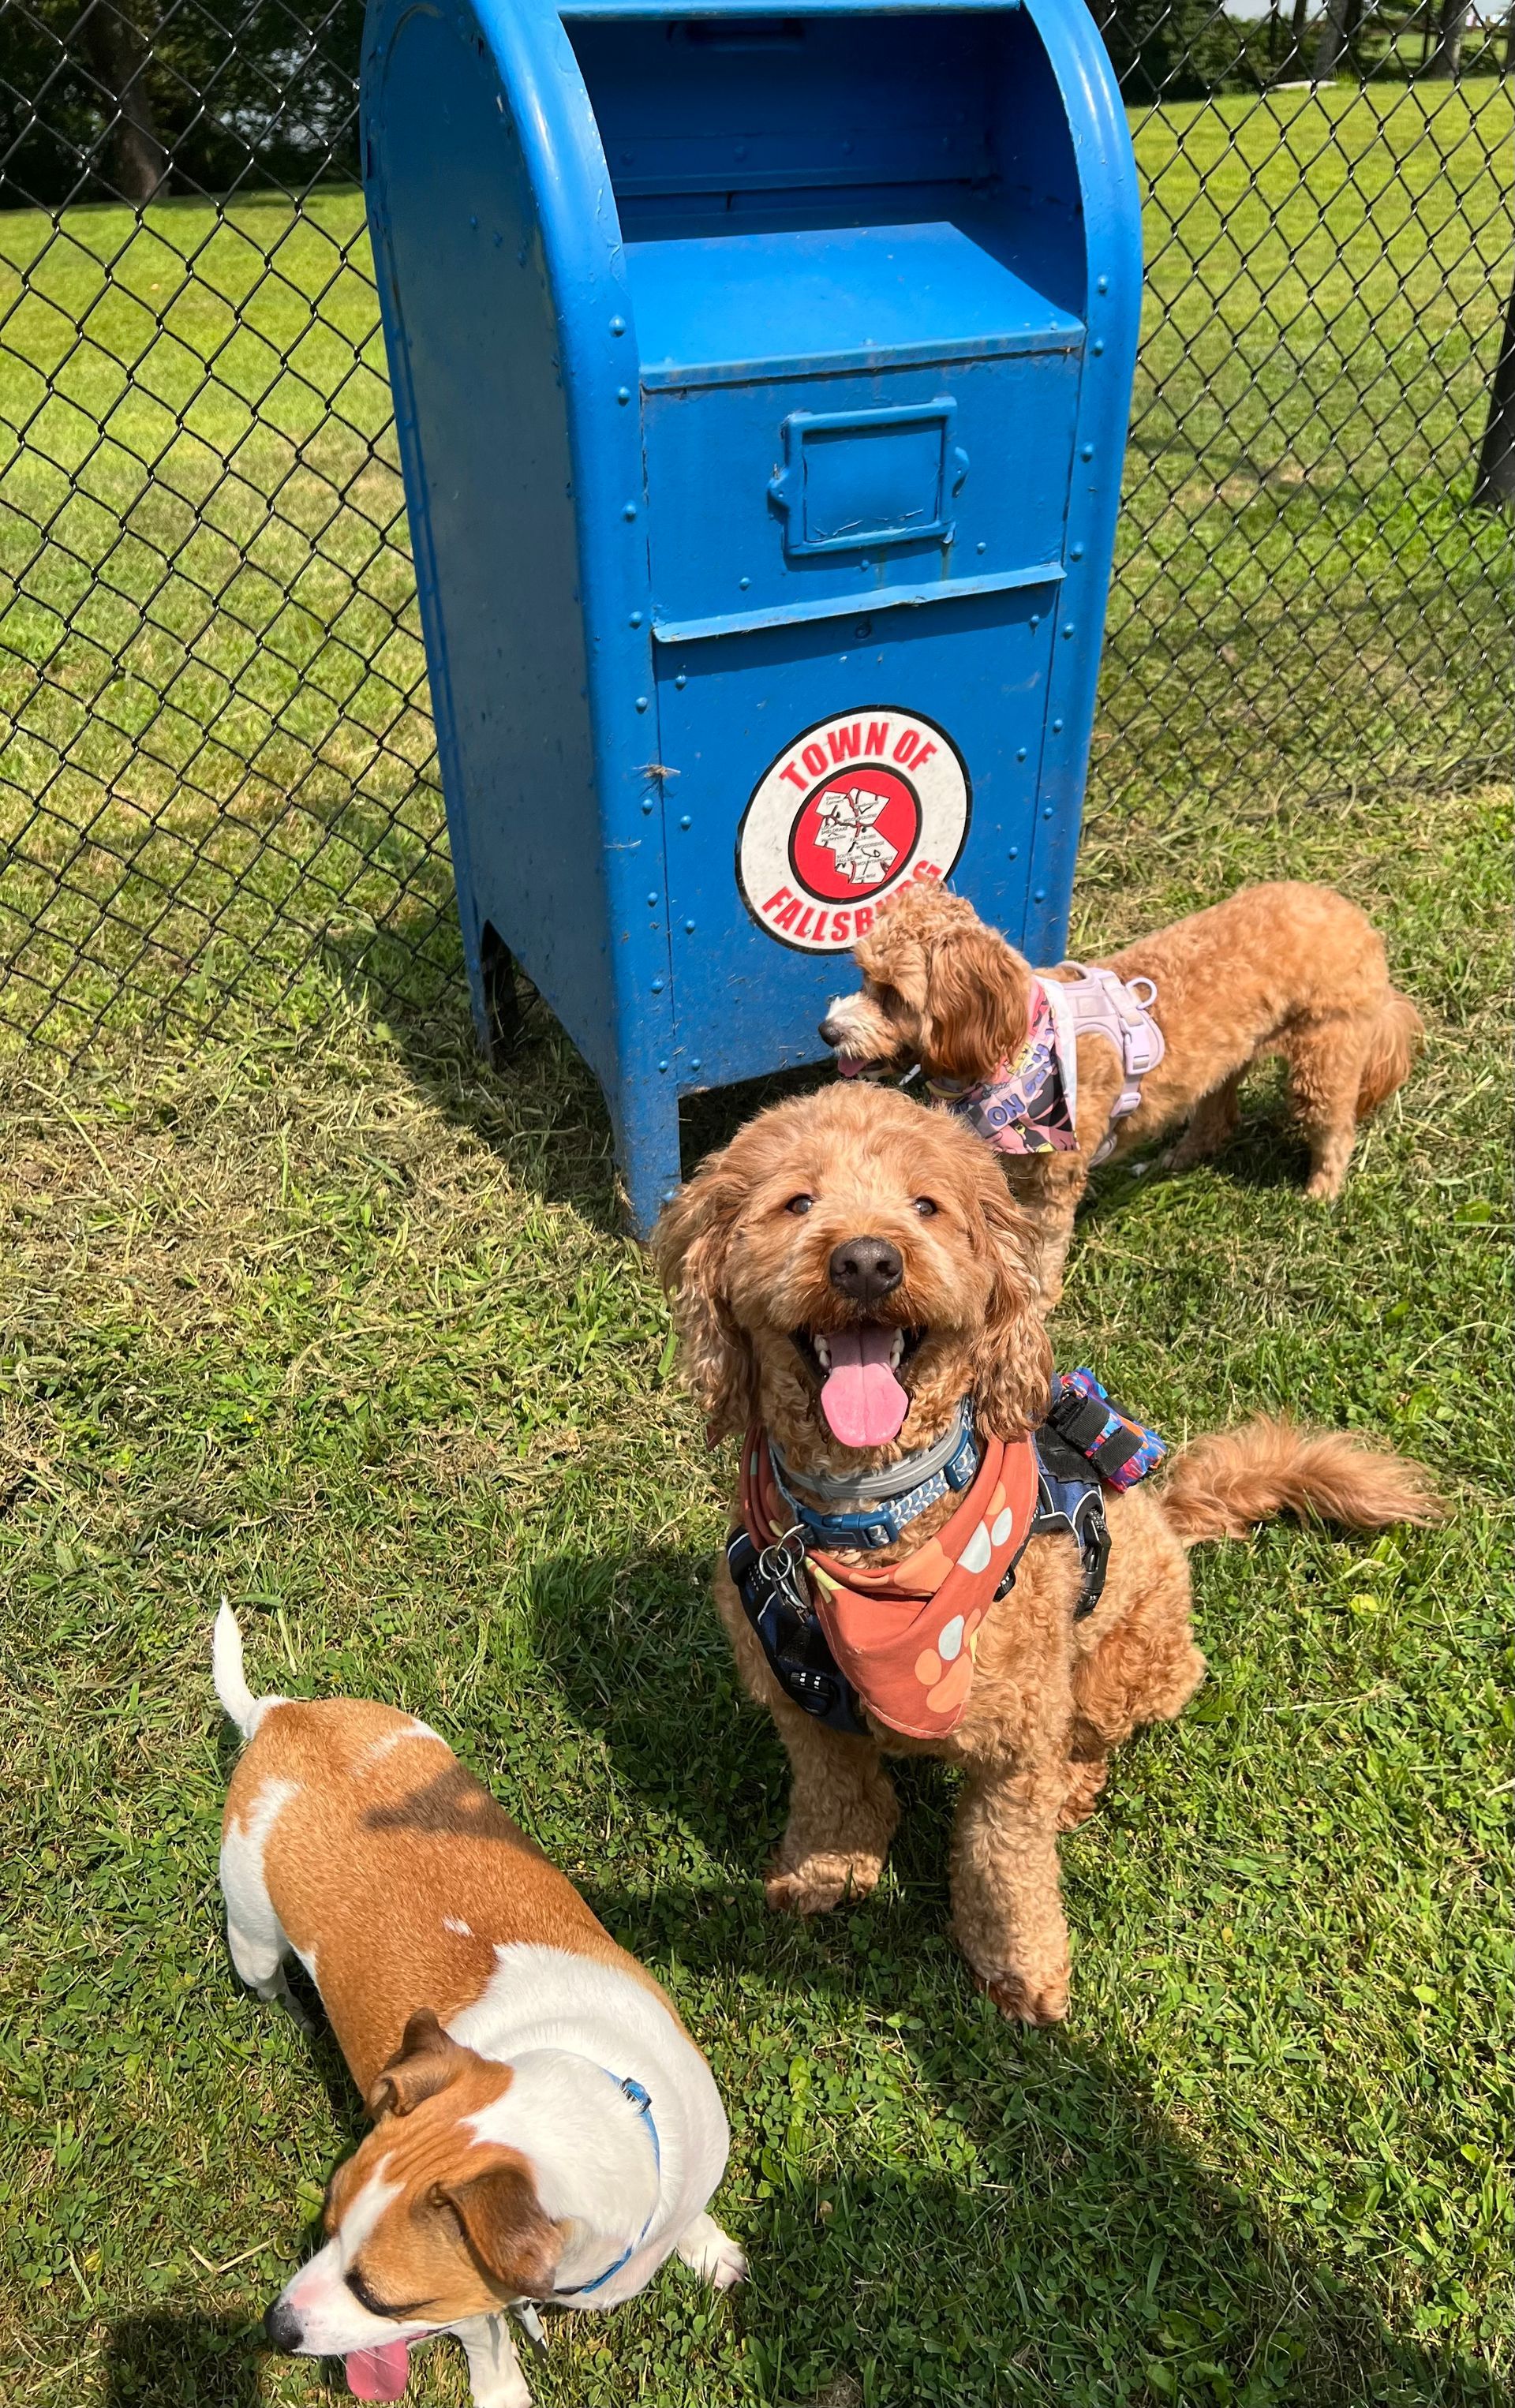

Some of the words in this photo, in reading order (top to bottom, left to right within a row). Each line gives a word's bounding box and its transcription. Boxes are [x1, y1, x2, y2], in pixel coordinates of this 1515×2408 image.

[779, 722, 889, 791] TOWN
[892, 729, 938, 772] OF
[761, 860, 943, 941] FALLSBG
